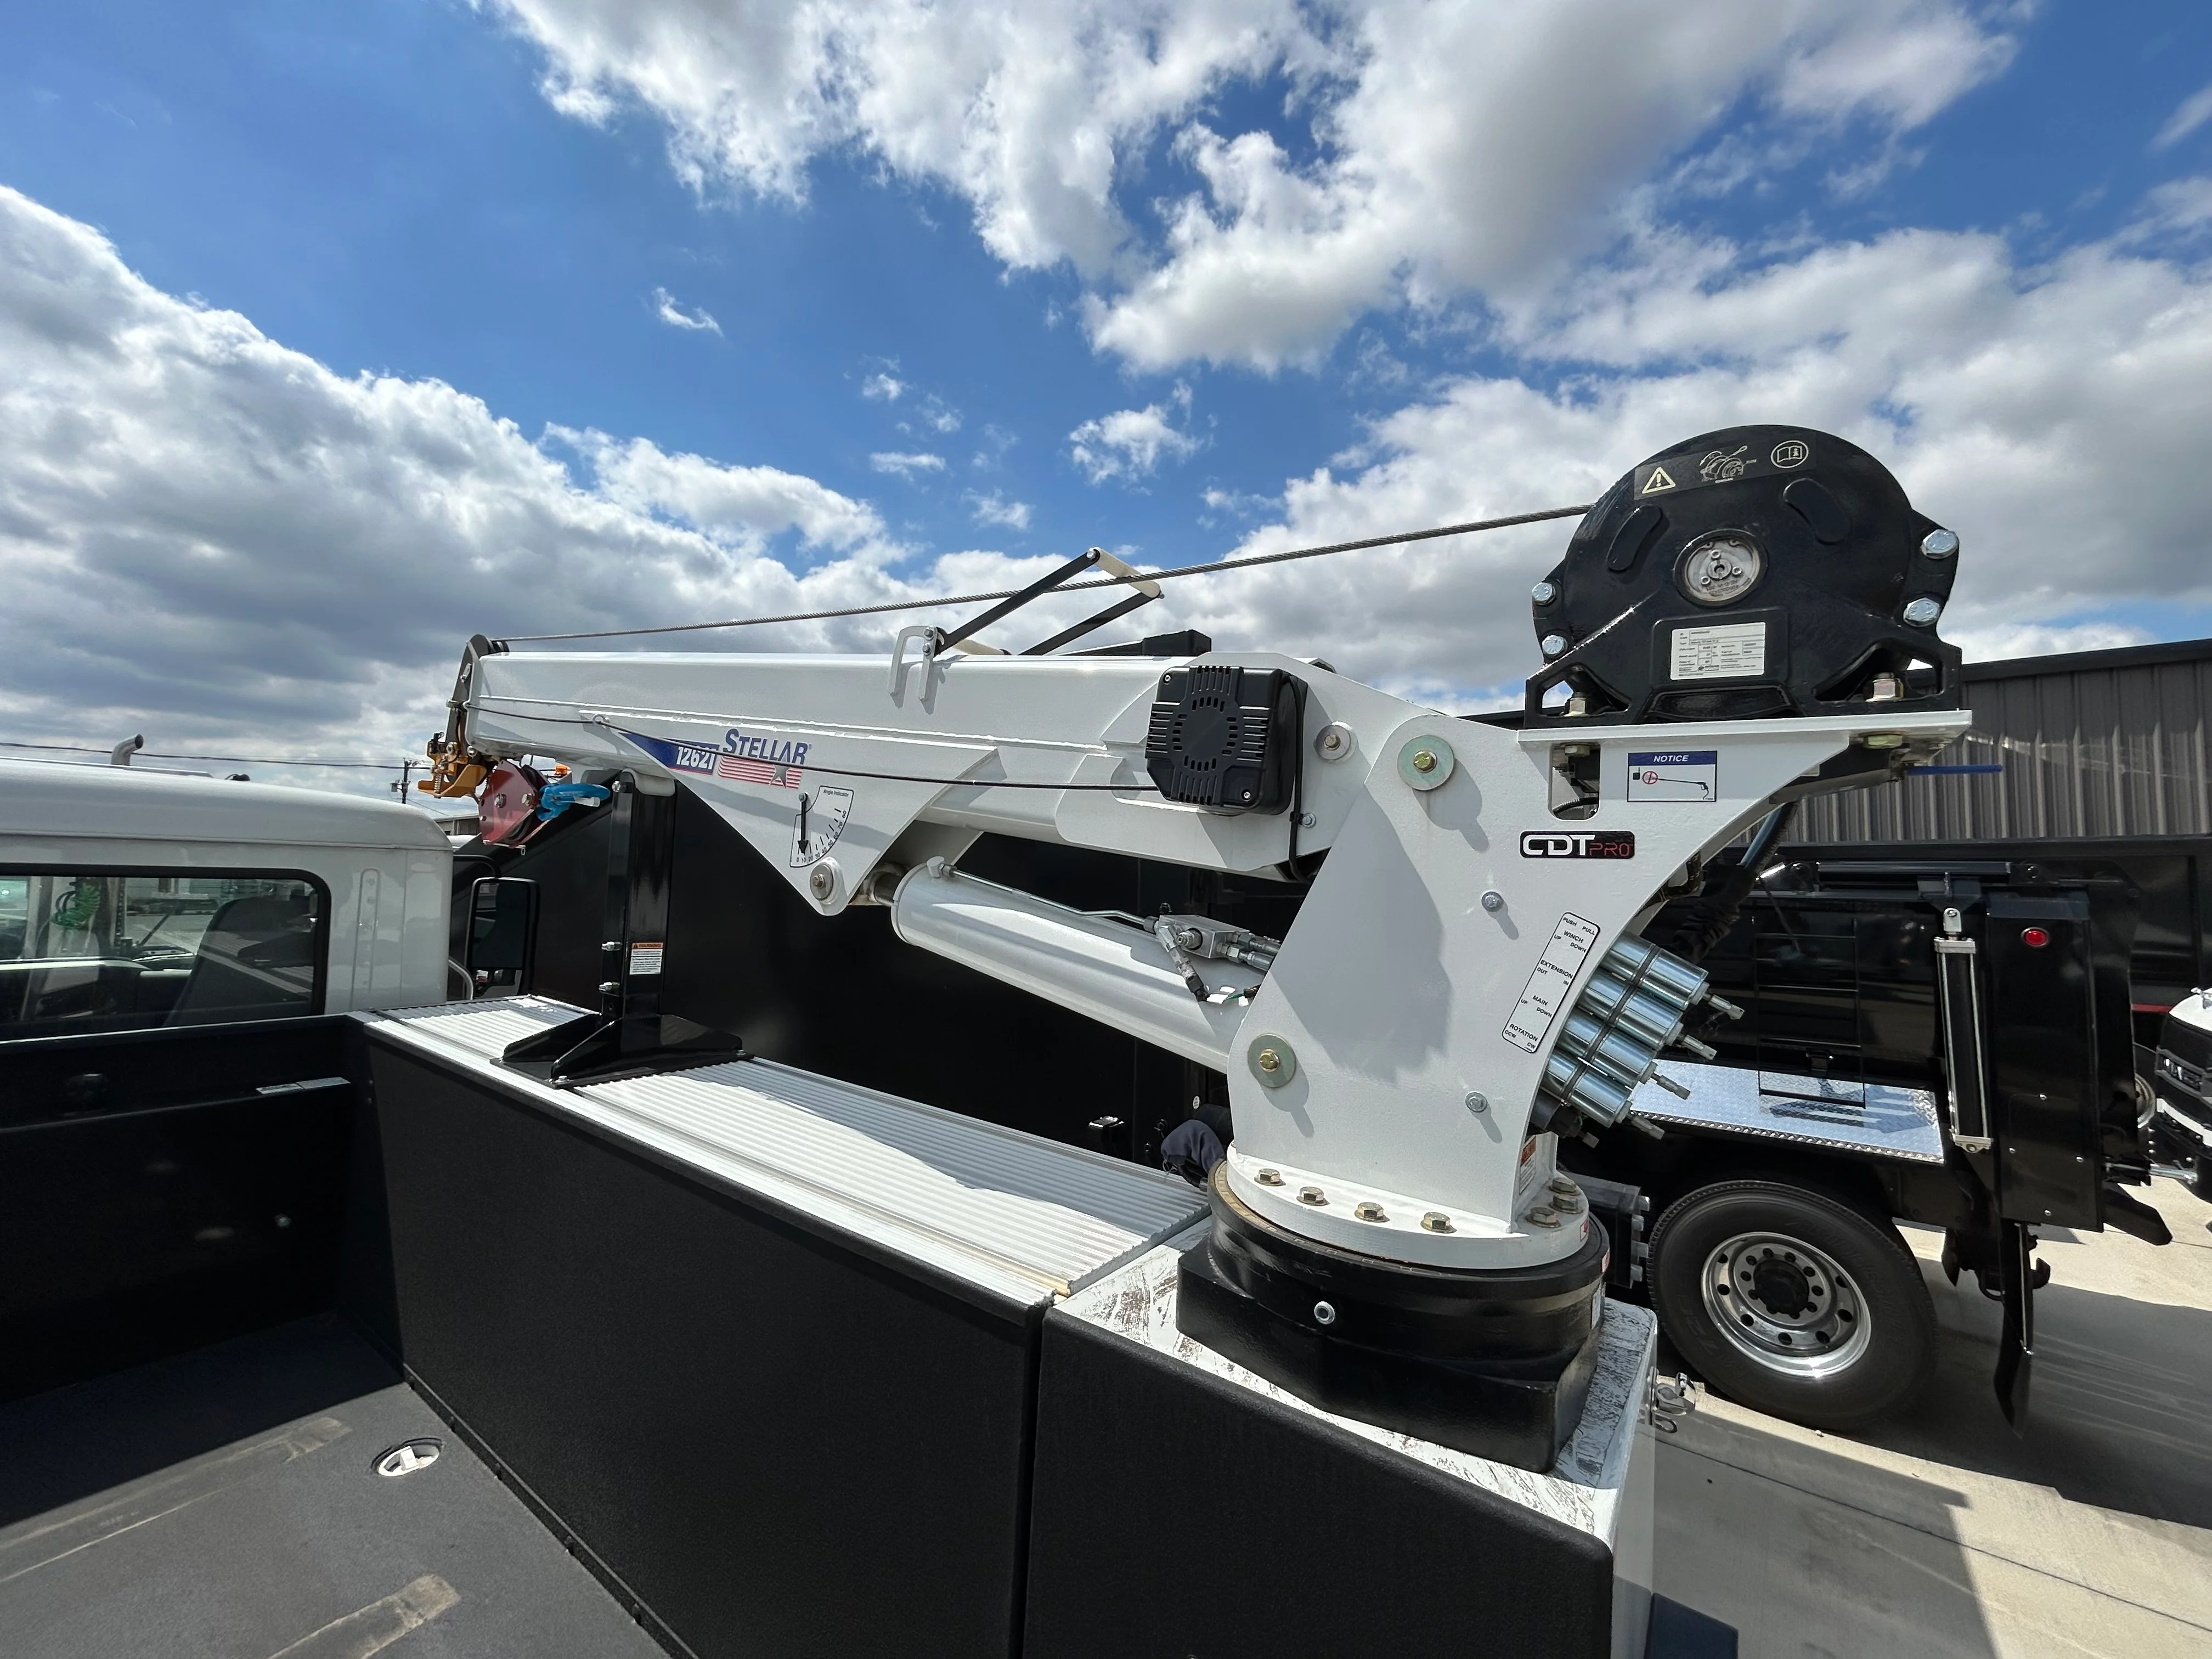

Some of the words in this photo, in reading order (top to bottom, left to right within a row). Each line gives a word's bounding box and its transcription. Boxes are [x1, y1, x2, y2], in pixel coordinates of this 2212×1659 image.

[842, 810, 847, 819] 80
[1562, 917, 1578, 927] PUSH
[1582, 926, 1595, 935] PULL
[1564, 930, 1584, 944] WINCH
[1570, 942, 1587, 953] DOWN
[1537, 967, 1548, 975] OUT
[1540, 959, 1573, 979] EXTENSION
[1532, 995, 1548, 1006] MAIN
[1536, 1007, 1553, 1018] DOWN
[1504, 1029, 1517, 1039] CCW
[1509, 1023, 1538, 1042] ROTATION
